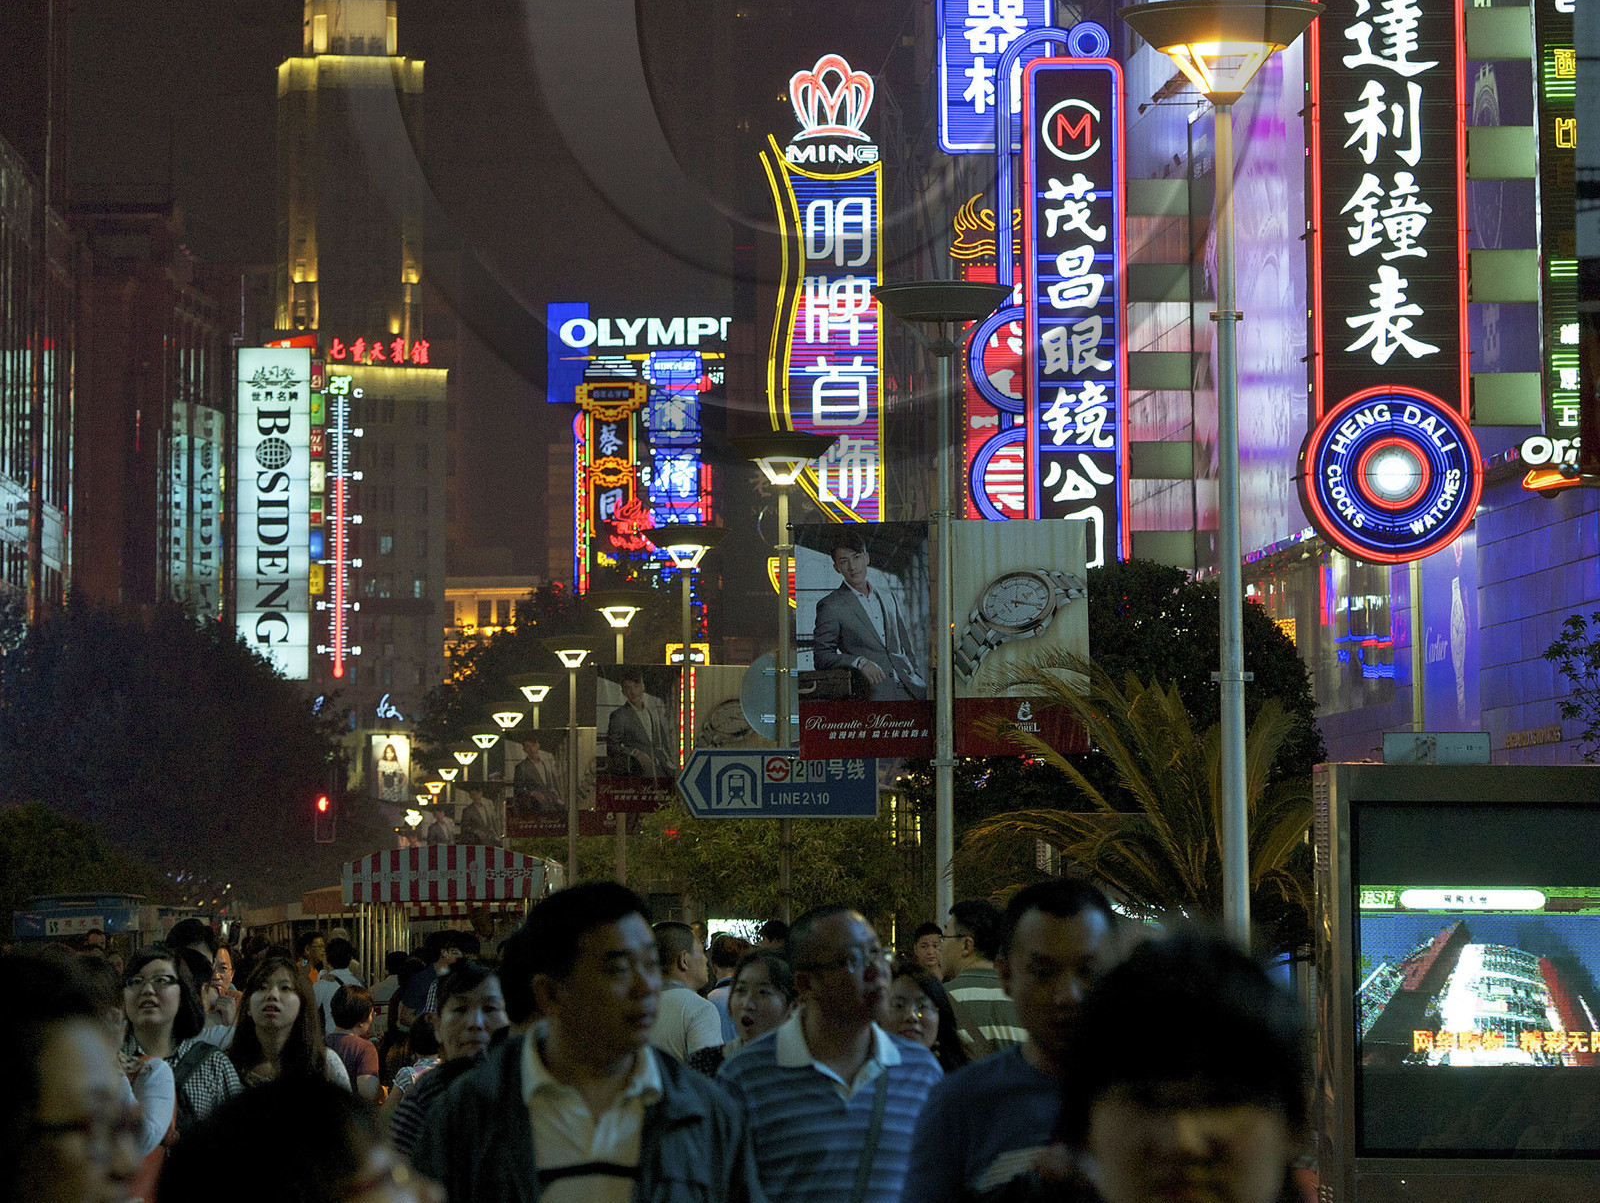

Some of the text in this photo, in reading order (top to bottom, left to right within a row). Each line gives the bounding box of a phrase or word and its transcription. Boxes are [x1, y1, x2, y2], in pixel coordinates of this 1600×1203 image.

[785, 144, 879, 163] MING
[1331, 404, 1391, 455] HENG
[1403, 405, 1457, 453] DALI
[1327, 464, 1366, 528] CLOCKS
[1409, 468, 1461, 535] WATCHES
[805, 713, 915, 731] Romantic Moment
[795, 762, 805, 777] 2
[810, 761, 824, 777] 10
[827, 758, 866, 780] 号线
[770, 792, 800, 805] LINE
